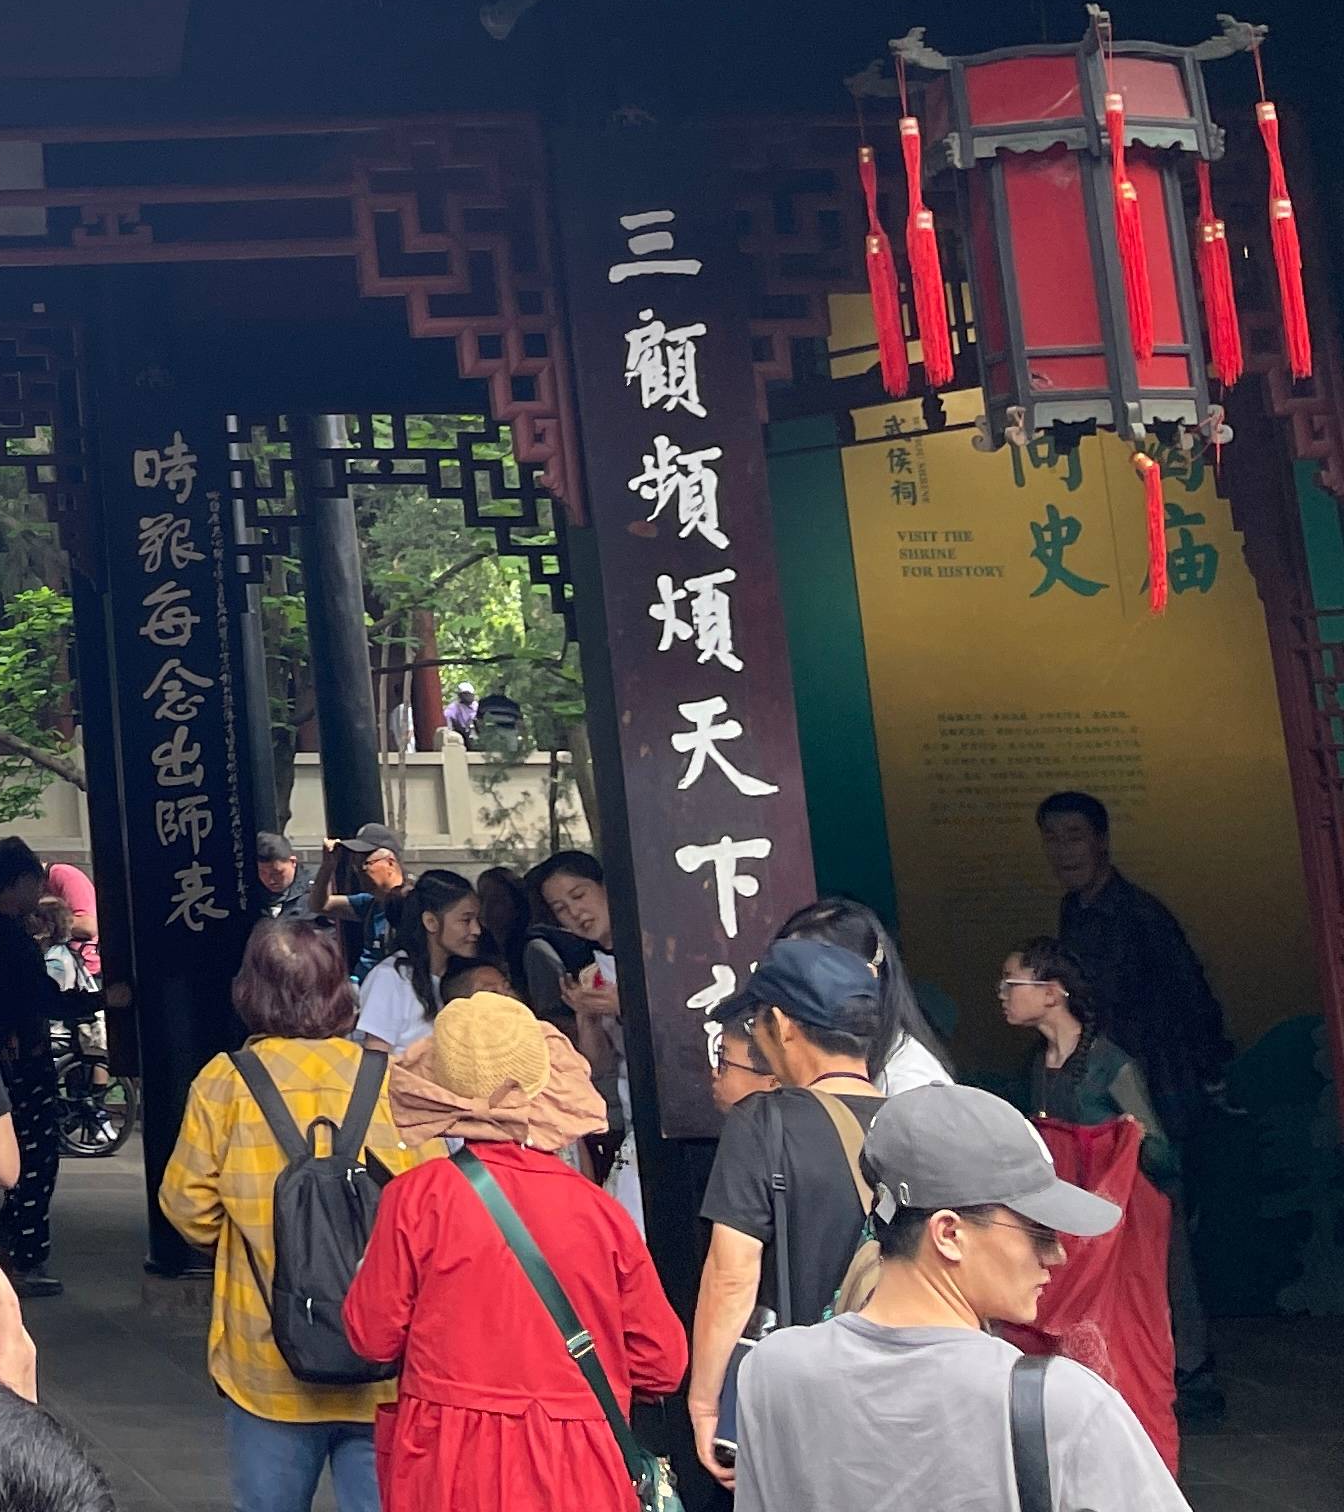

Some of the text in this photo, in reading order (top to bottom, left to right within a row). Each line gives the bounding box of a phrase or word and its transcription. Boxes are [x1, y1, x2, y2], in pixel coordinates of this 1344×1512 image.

[897, 530, 975, 544] VISIT THE
[898, 548, 958, 560] SHRINE
[901, 565, 1006, 579] FOR HISTORY
